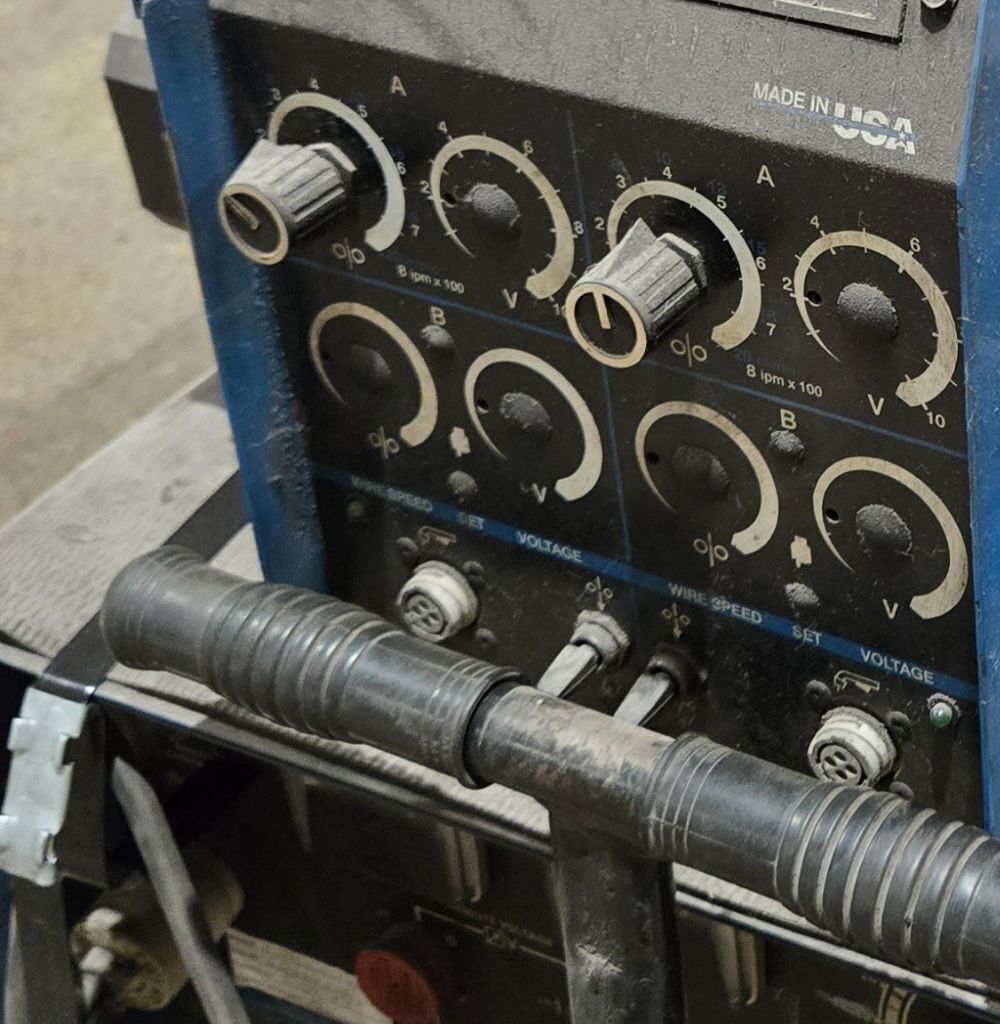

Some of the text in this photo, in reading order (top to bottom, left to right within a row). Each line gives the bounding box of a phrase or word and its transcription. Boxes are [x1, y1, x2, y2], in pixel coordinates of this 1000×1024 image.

[310, 77, 320, 91] 4
[390, 75, 407, 97] A
[271, 87, 282, 102] 3
[357, 104, 369, 119] 5
[753, 81, 917, 156] MADE IN USA
[438, 121, 448, 134] 4
[522, 140, 534, 154] 6
[397, 161, 407, 176] 6
[662, 166, 673, 180] 4
[756, 164, 775, 188] A
[419, 180, 431, 194] 2
[616, 174, 627, 189] 3
[716, 195, 728, 210] 5
[573, 221, 583, 236] 8
[594, 217, 605, 231] 2
[810, 214, 820, 229] 4
[411, 224, 420, 238] 7
[910, 237, 921, 252] 6
[756, 256, 767, 270] 6
[409, 267, 432, 286] ipm
[443, 277, 465, 295] 100
[782, 277, 793, 291] 2
[503, 289, 518, 309] V
[430, 305, 446, 326] B
[766, 322, 777, 336] 7
[746, 363, 757, 378] 8
[760, 368, 785, 387] ipm
[799, 381, 823, 398] 100
[868, 393, 886, 416] V
[780, 408, 797, 430] B
[926, 411, 946, 429] 10
[456, 511, 486, 531] SET
[517, 530, 584, 564] VOLTAGE
[883, 599, 898, 620] V
[667, 582, 935, 686] WIRE SPEED SET VOLTAGE
